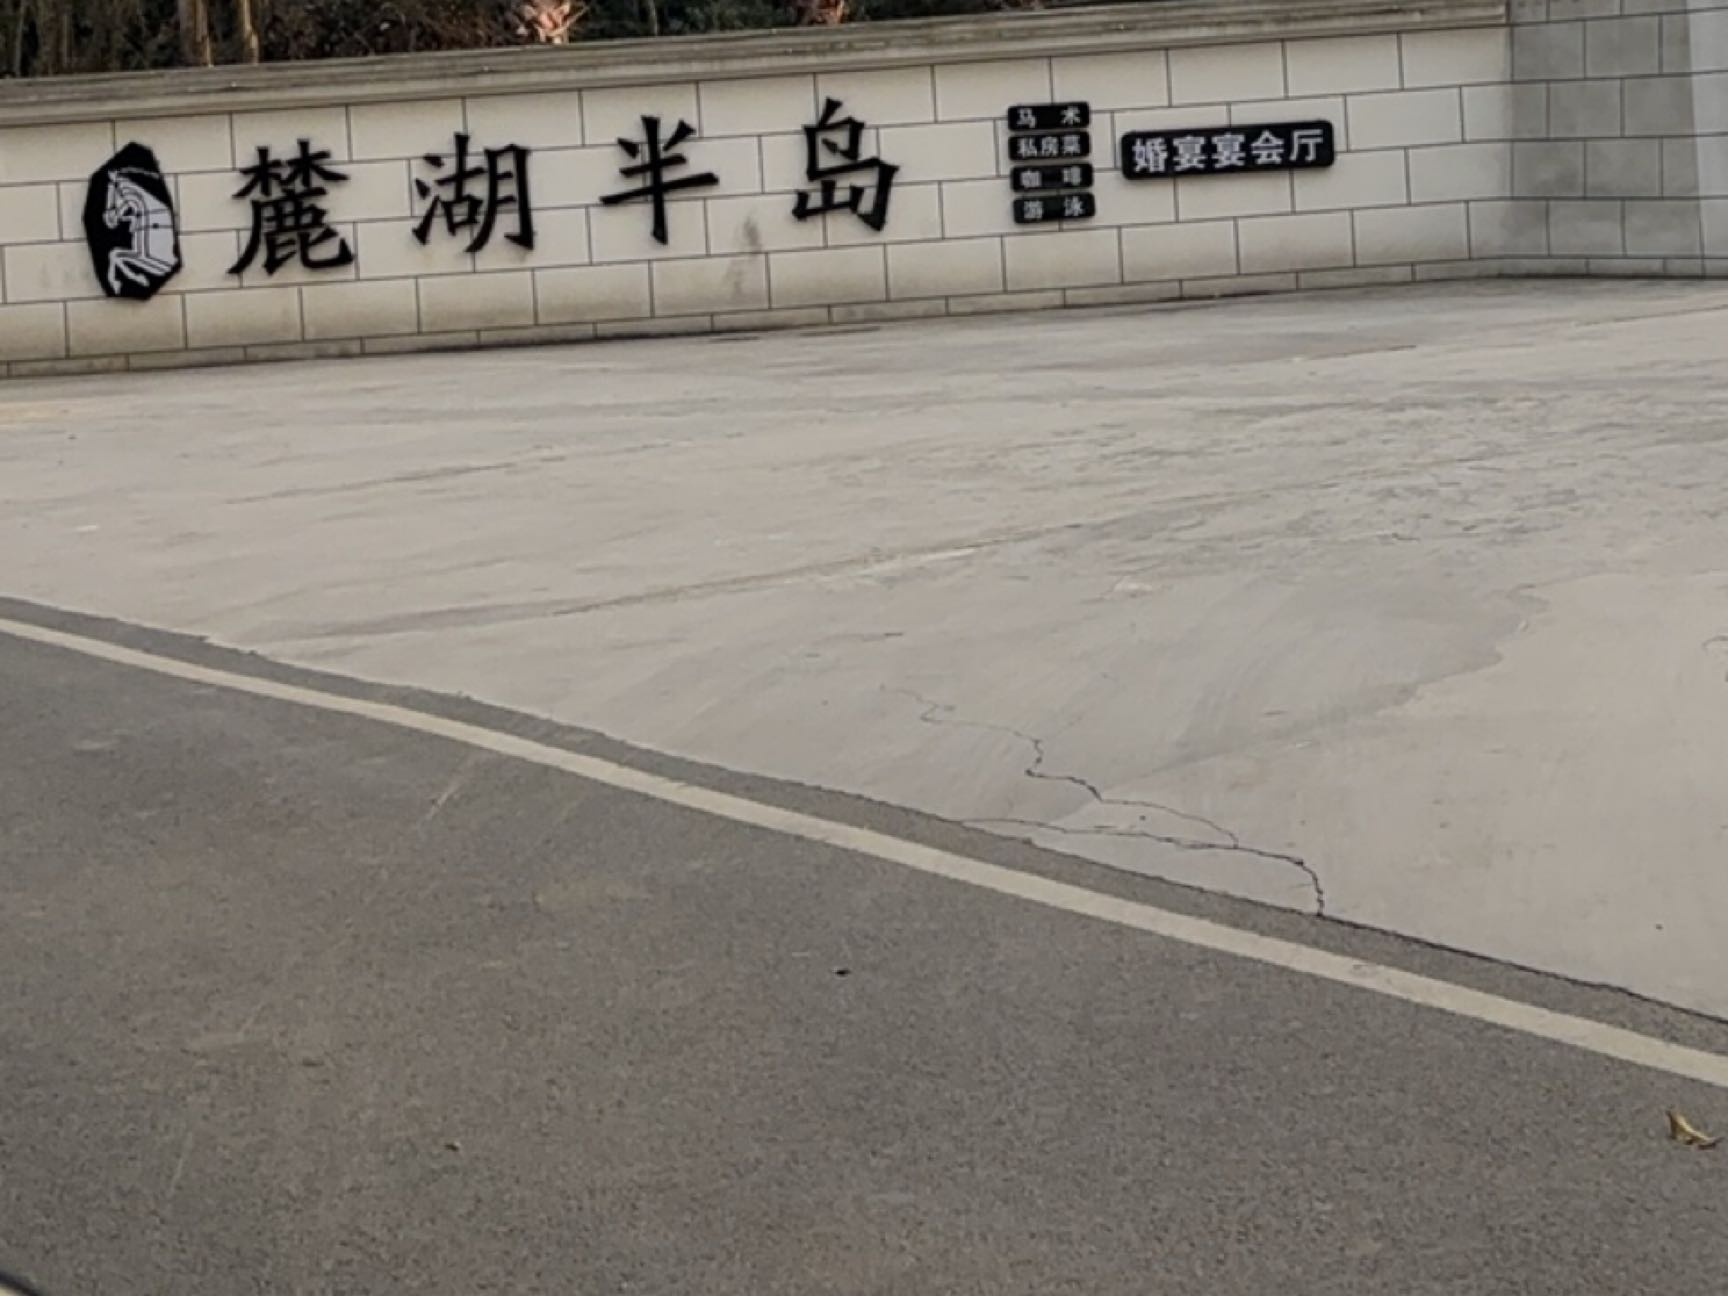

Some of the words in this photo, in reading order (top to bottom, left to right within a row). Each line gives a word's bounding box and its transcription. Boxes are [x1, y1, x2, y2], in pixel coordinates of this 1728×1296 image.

[227, 97, 899, 275] 麓湖半岛
[1132, 129, 1324, 173] 婚宴宴会厅
